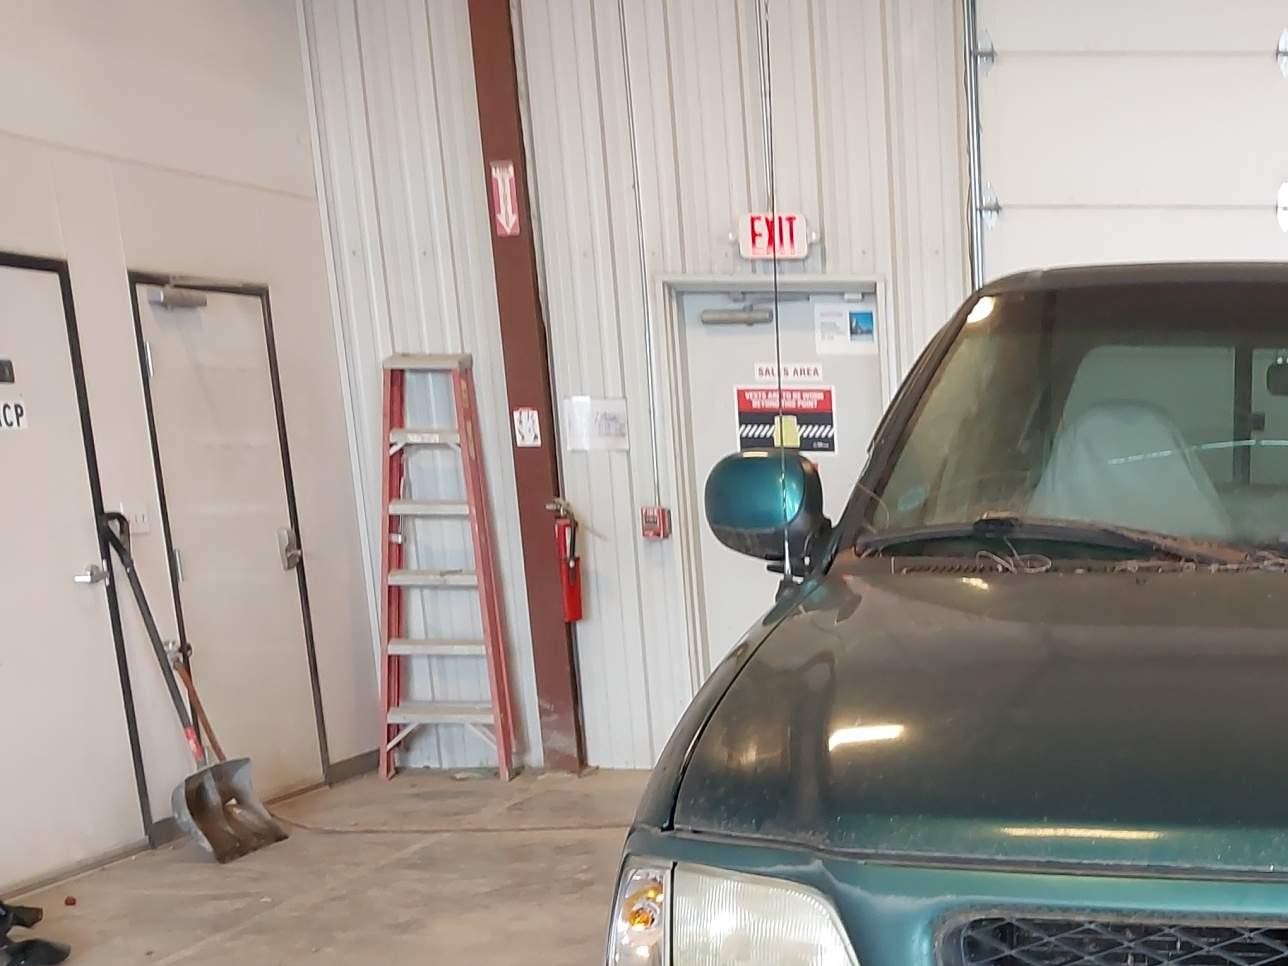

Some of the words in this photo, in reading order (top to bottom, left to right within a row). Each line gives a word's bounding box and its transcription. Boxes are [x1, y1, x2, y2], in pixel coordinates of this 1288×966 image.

[751, 215, 797, 255] EXIT
[758, 367, 789, 377] SALS
[793, 367, 819, 377] AREA
[0, 403, 24, 427] CP
